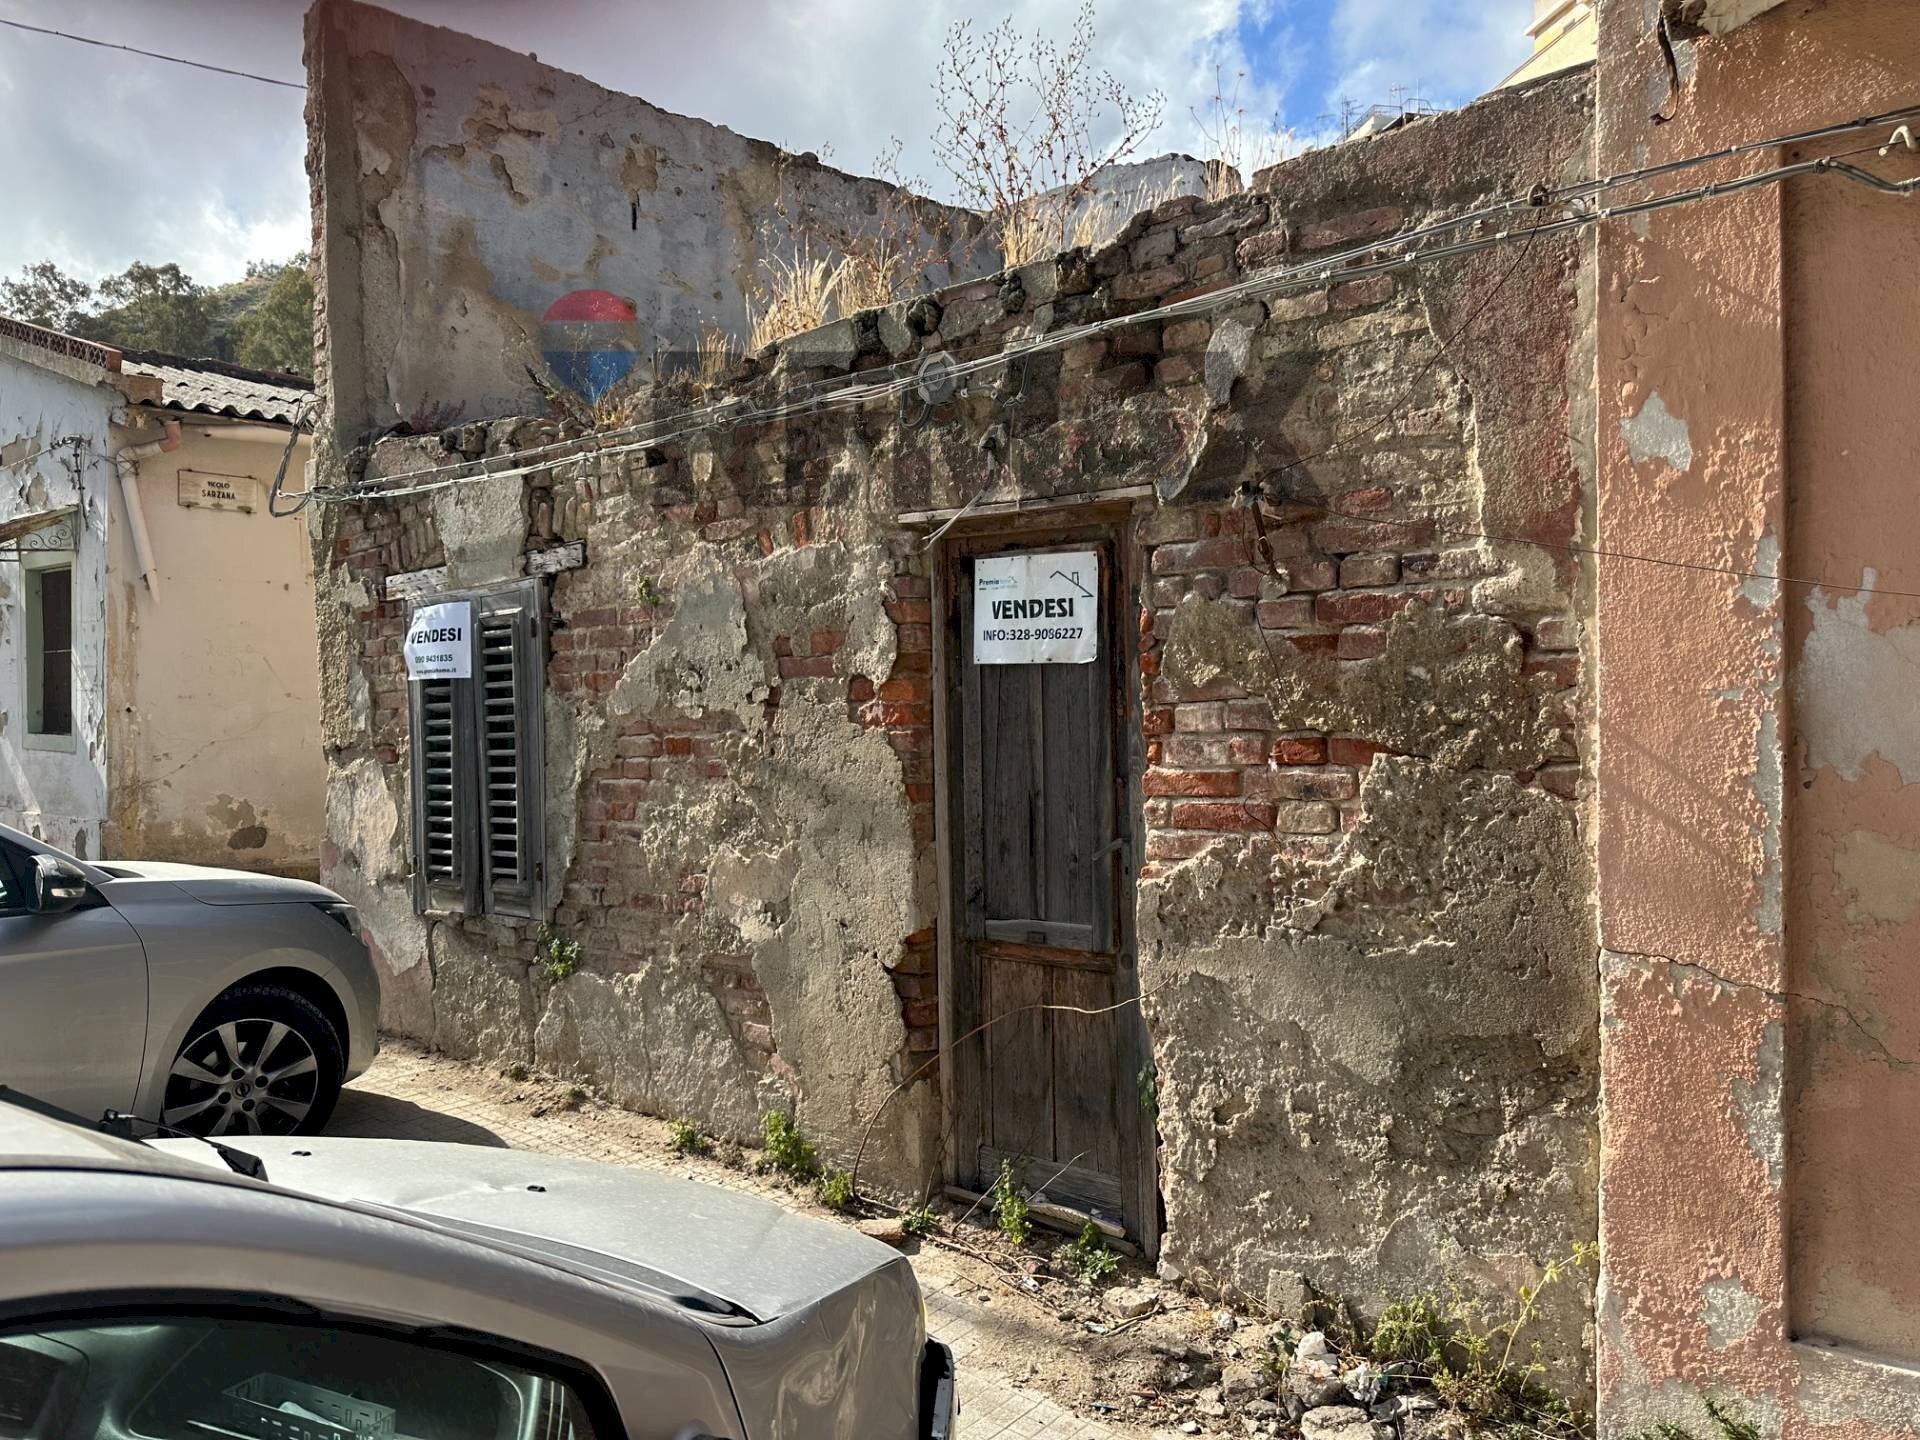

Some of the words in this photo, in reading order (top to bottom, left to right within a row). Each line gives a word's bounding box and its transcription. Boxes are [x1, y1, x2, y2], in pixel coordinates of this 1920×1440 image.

[207, 481, 231, 489] VICOLO
[201, 489, 236, 500] SARZANA
[991, 597, 1074, 620] VENDESI
[411, 627, 462, 644] VENDESI
